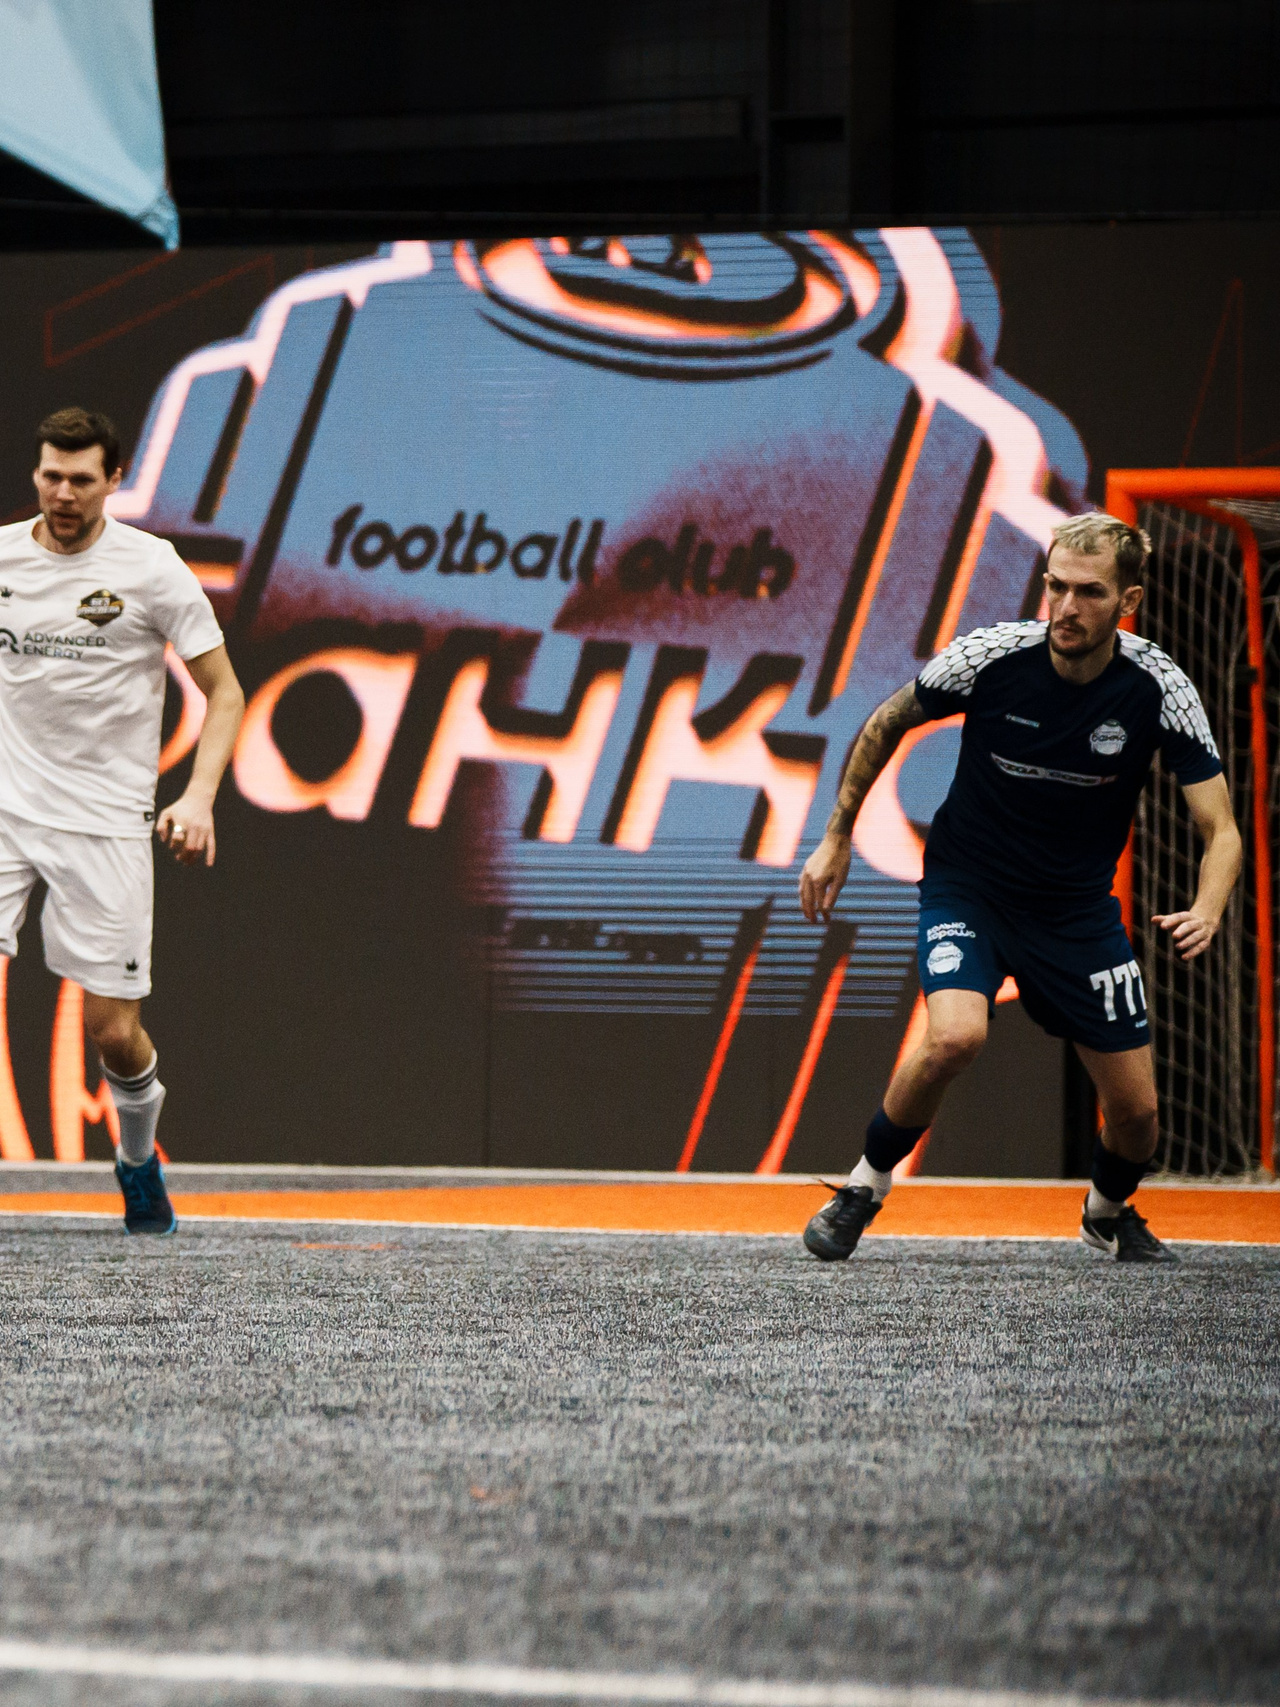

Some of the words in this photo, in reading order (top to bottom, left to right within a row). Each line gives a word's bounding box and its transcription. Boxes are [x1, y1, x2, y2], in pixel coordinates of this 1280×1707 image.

[325, 503, 606, 583] football
[620, 521, 797, 599] club
[23, 632, 106, 647] ADVANCED
[23, 645, 84, 660] ENERGY
[1089, 959, 1147, 1021] 777
